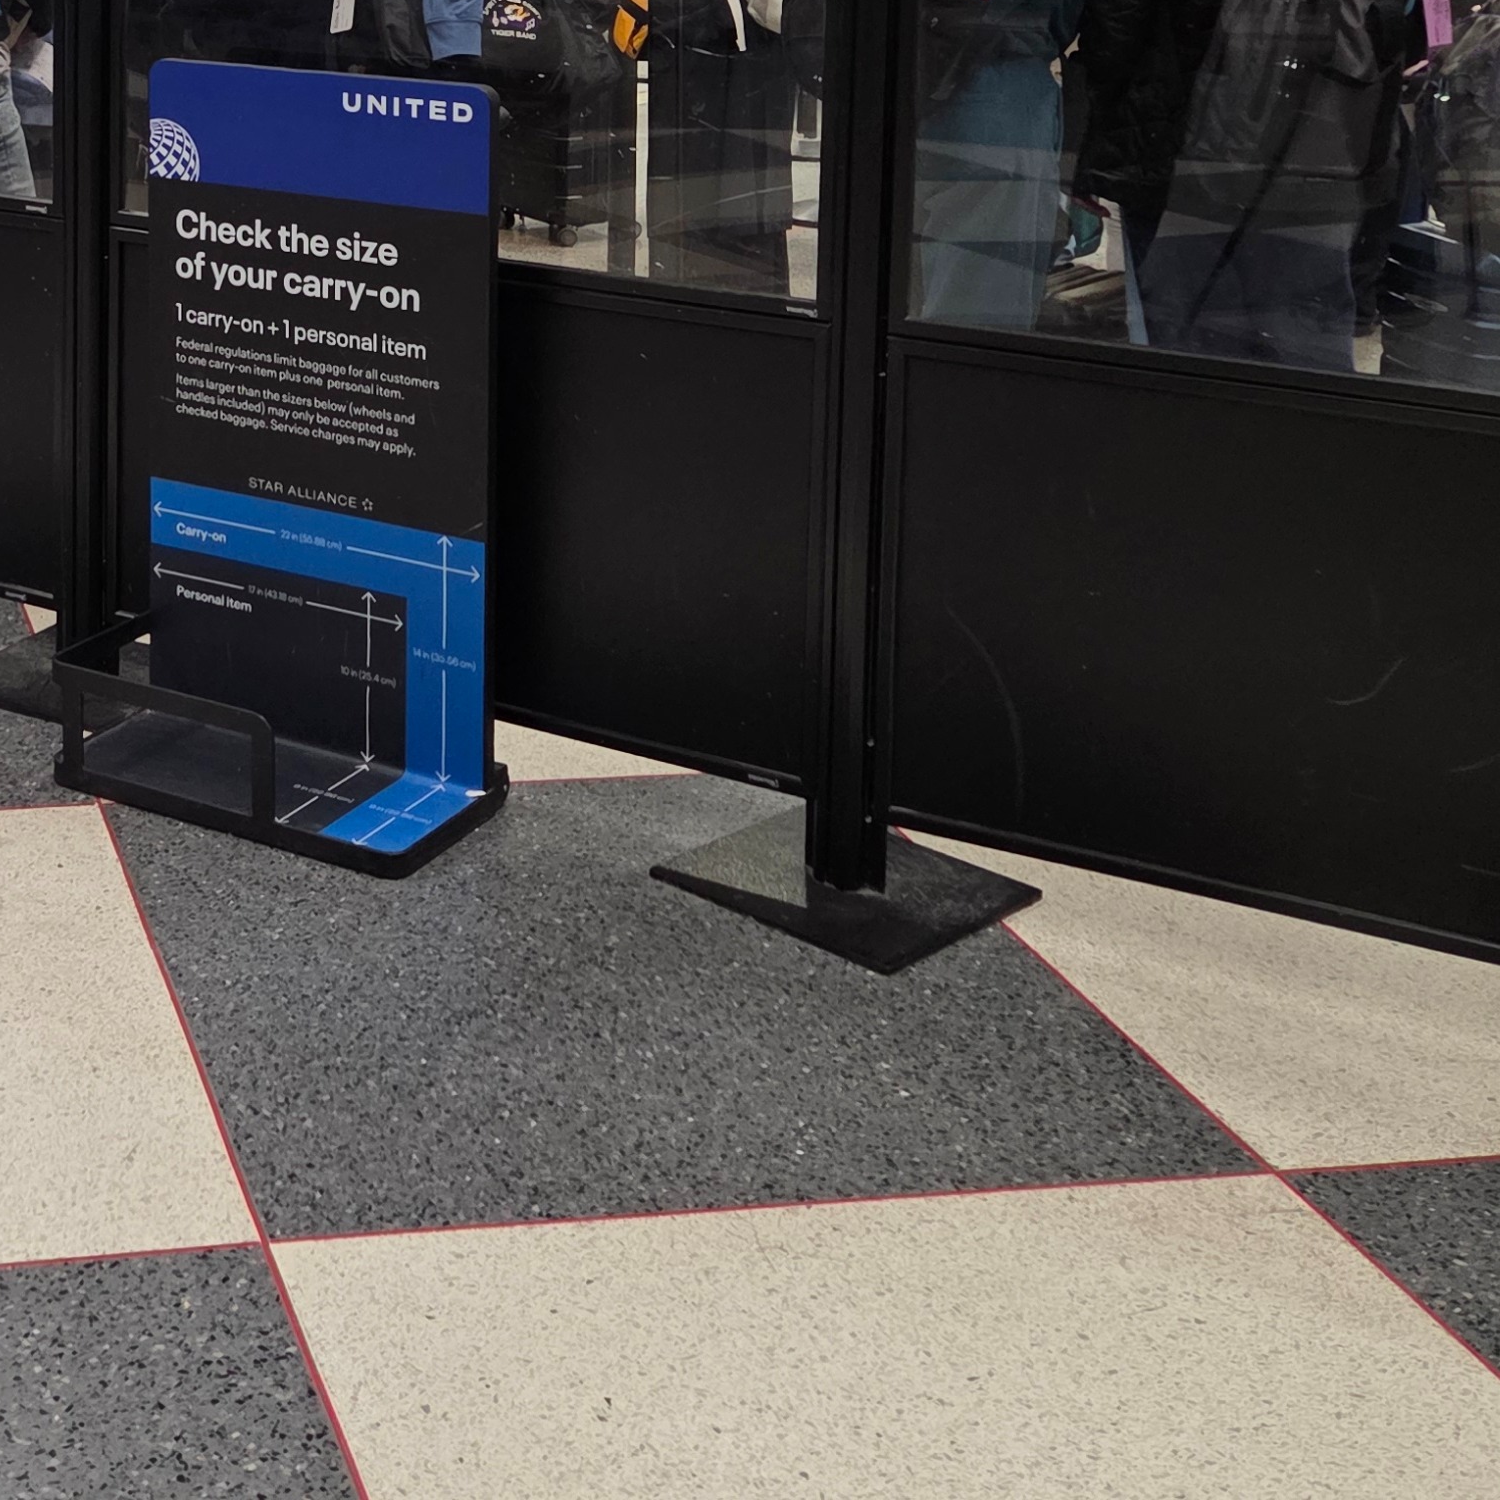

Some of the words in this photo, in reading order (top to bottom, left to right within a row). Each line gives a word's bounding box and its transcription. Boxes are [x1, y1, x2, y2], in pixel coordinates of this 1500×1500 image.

[342, 92, 473, 123] UNITED
[175, 208, 273, 250] Check
[278, 223, 330, 257] the
[335, 231, 399, 267] size
[175, 251, 206, 281] of
[210, 261, 278, 291] your
[283, 271, 421, 313] carry-on
[175, 302, 182, 322] 1
[185, 309, 264, 335] carry-on
[267, 322, 279, 335] +
[283, 319, 290, 339] 1
[294, 325, 377, 353] personal
[381, 334, 427, 361] item
[176, 336, 213, 353] Federal
[214, 345, 272, 364] regulations
[273, 353, 297, 367] limit
[299, 357, 346, 377] baggage
[348, 364, 363, 378] for
[365, 368, 378, 380] all
[380, 372, 440, 390] customers
[176, 352, 187, 363] to
[188, 355, 206, 367] one
[208, 358, 252, 374] carry-on
[253, 364, 277, 379] item
[278, 369, 301, 383] plus
[302, 375, 323, 386] one
[327, 378, 374, 394] personal
[375, 384, 405, 400] item.
[176, 372, 205, 388] Items
[205, 378, 235, 395] larger
[237, 384, 261, 398] than
[262, 388, 280, 401] the
[281, 392, 313, 408] sizers
[314, 397, 347, 413] below
[348, 401, 392, 421] (wheels
[394, 413, 416, 425] and
[176, 388, 215, 405] handles
[217, 394, 265, 415] included)
[267, 406, 290, 421] may
[291, 410, 314, 425] only
[316, 412, 330, 425] be
[332, 417, 384, 436] accepted
[385, 426, 399, 438] as
[175, 403, 218, 420] checked
[220, 410, 269, 430] baggage.
[270, 418, 310, 437] Service
[311, 428, 355, 445] charges
[357, 437, 381, 452] may
[382, 442, 416, 458] apply.
[248, 476, 284, 494] STAR
[287, 485, 358, 509] ALLIANCE
[176, 522, 227, 544] Carry-on
[280, 529, 290, 540] 22
[176, 584, 225, 606] Personal
[340, 665, 350, 676] 10
[350, 669, 358, 678] in
[412, 647, 421, 658] 14
[422, 650, 430, 660] in
